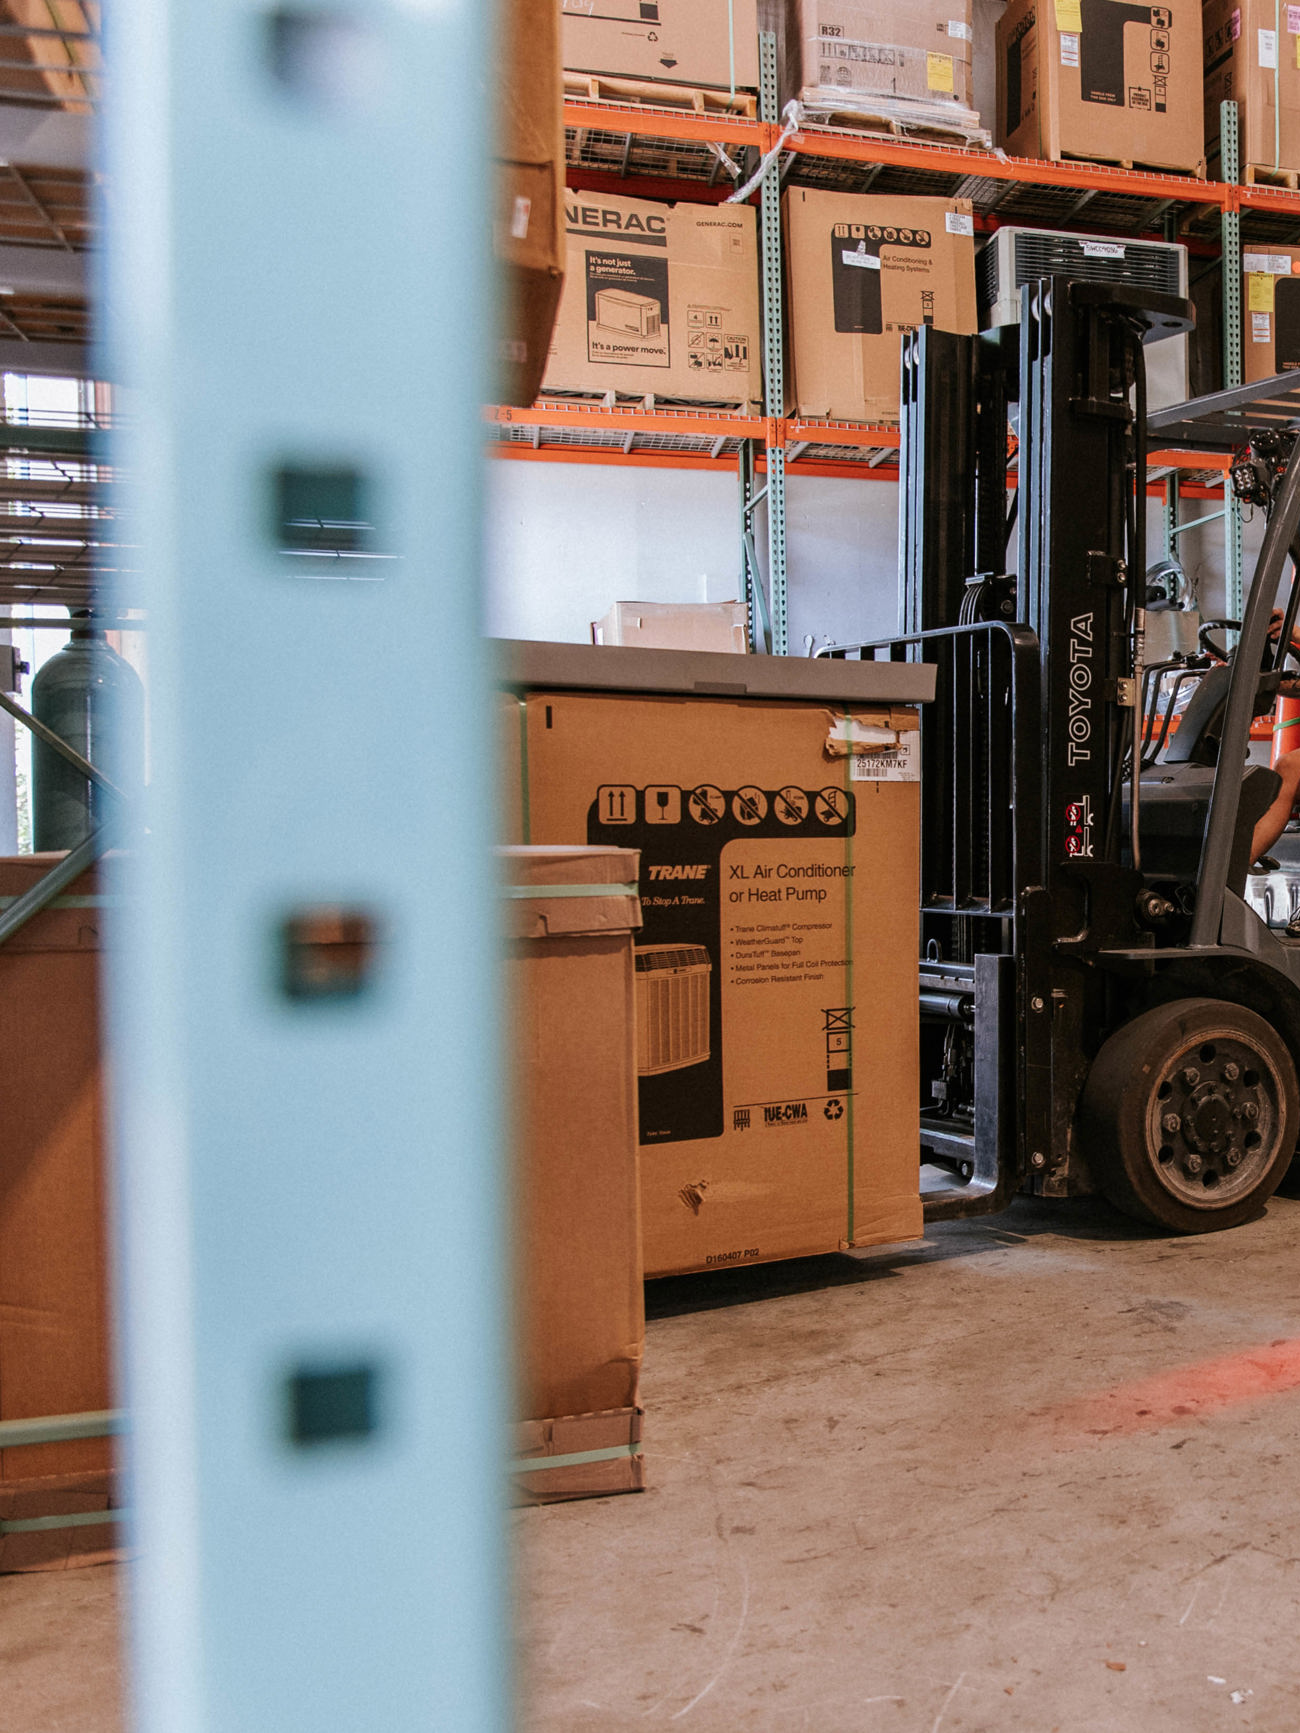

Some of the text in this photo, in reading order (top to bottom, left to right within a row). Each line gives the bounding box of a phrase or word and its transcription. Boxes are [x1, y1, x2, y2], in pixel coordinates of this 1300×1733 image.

[821, 26, 841, 37] R32
[566, 205, 666, 234] NERAC
[696, 221, 743, 229] GENERAC.COM
[589, 255, 632, 267] It's not just
[891, 255, 928, 266] Conditioning
[596, 265, 636, 276] generator.
[883, 264, 930, 274] Heating Systems
[592, 341, 604, 350] It's
[612, 344, 639, 354] power
[640, 346, 666, 355] move.
[1068, 612, 1093, 767] TOYOTA
[857, 758, 908, 769] 25172KM7KF
[648, 865, 709, 880] TRANE
[729, 863, 856, 880] XL Air Conditioner
[642, 895, 705, 907] To Stop A Trane.
[729, 886, 827, 904] or Heat Pump
[735, 925, 754, 933] Trane
[792, 922, 832, 931] Compressor
[791, 936, 804, 944] Top
[771, 950, 801, 958] Basepan
[736, 964, 754, 972] Metal
[756, 963, 779, 971] Panels
[792, 961, 804, 969] Full
[806, 960, 819, 968] Coil
[820, 959, 853, 967] Protection
[735, 973, 824, 985] Corrosion Resistant Finish
[836, 1037, 842, 1046] 5
[764, 1103, 808, 1122] IUE-CWA
[705, 1248, 760, 1264] D160407 P02
